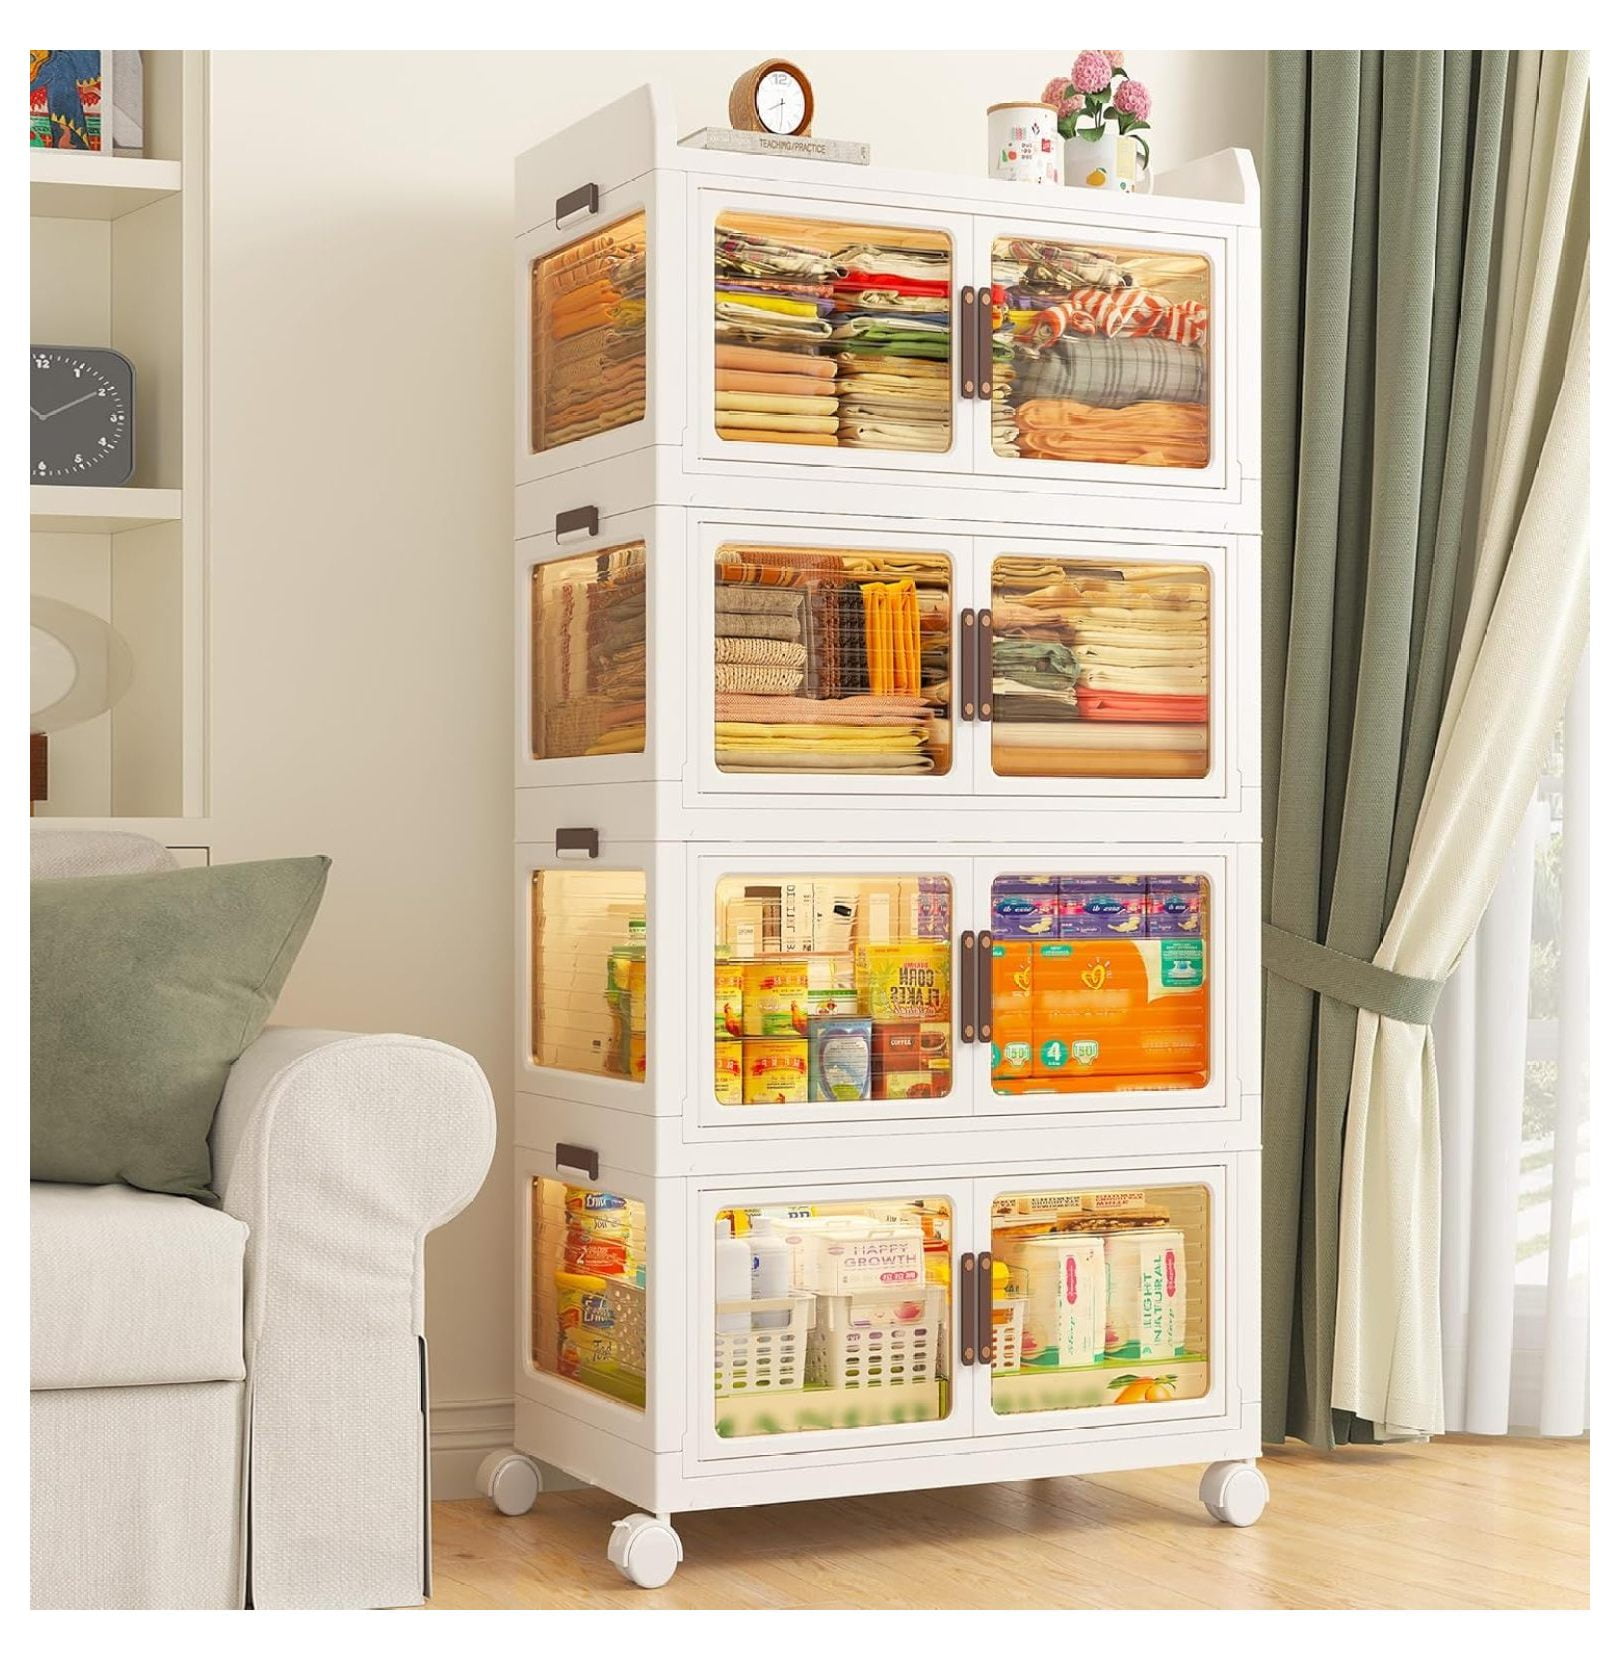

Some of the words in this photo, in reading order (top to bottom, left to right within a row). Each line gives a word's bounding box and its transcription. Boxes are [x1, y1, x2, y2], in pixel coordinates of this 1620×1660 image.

[771, 73, 787, 85] 12
[760, 138, 826, 154] TEACHING/PRACTICE
[35, 358, 50, 369] 12
[73, 368, 80, 378] 1
[98, 388, 106, 397] 2
[110, 414, 117, 423] 3
[98, 437, 107, 446] 4
[74, 453, 82, 463] 5
[38, 461, 47, 470] 6
[1047, 1042, 1061, 1061] 4
[854, 1243, 909, 1256] HAPPY
[844, 1253, 917, 1268] GROWTH
